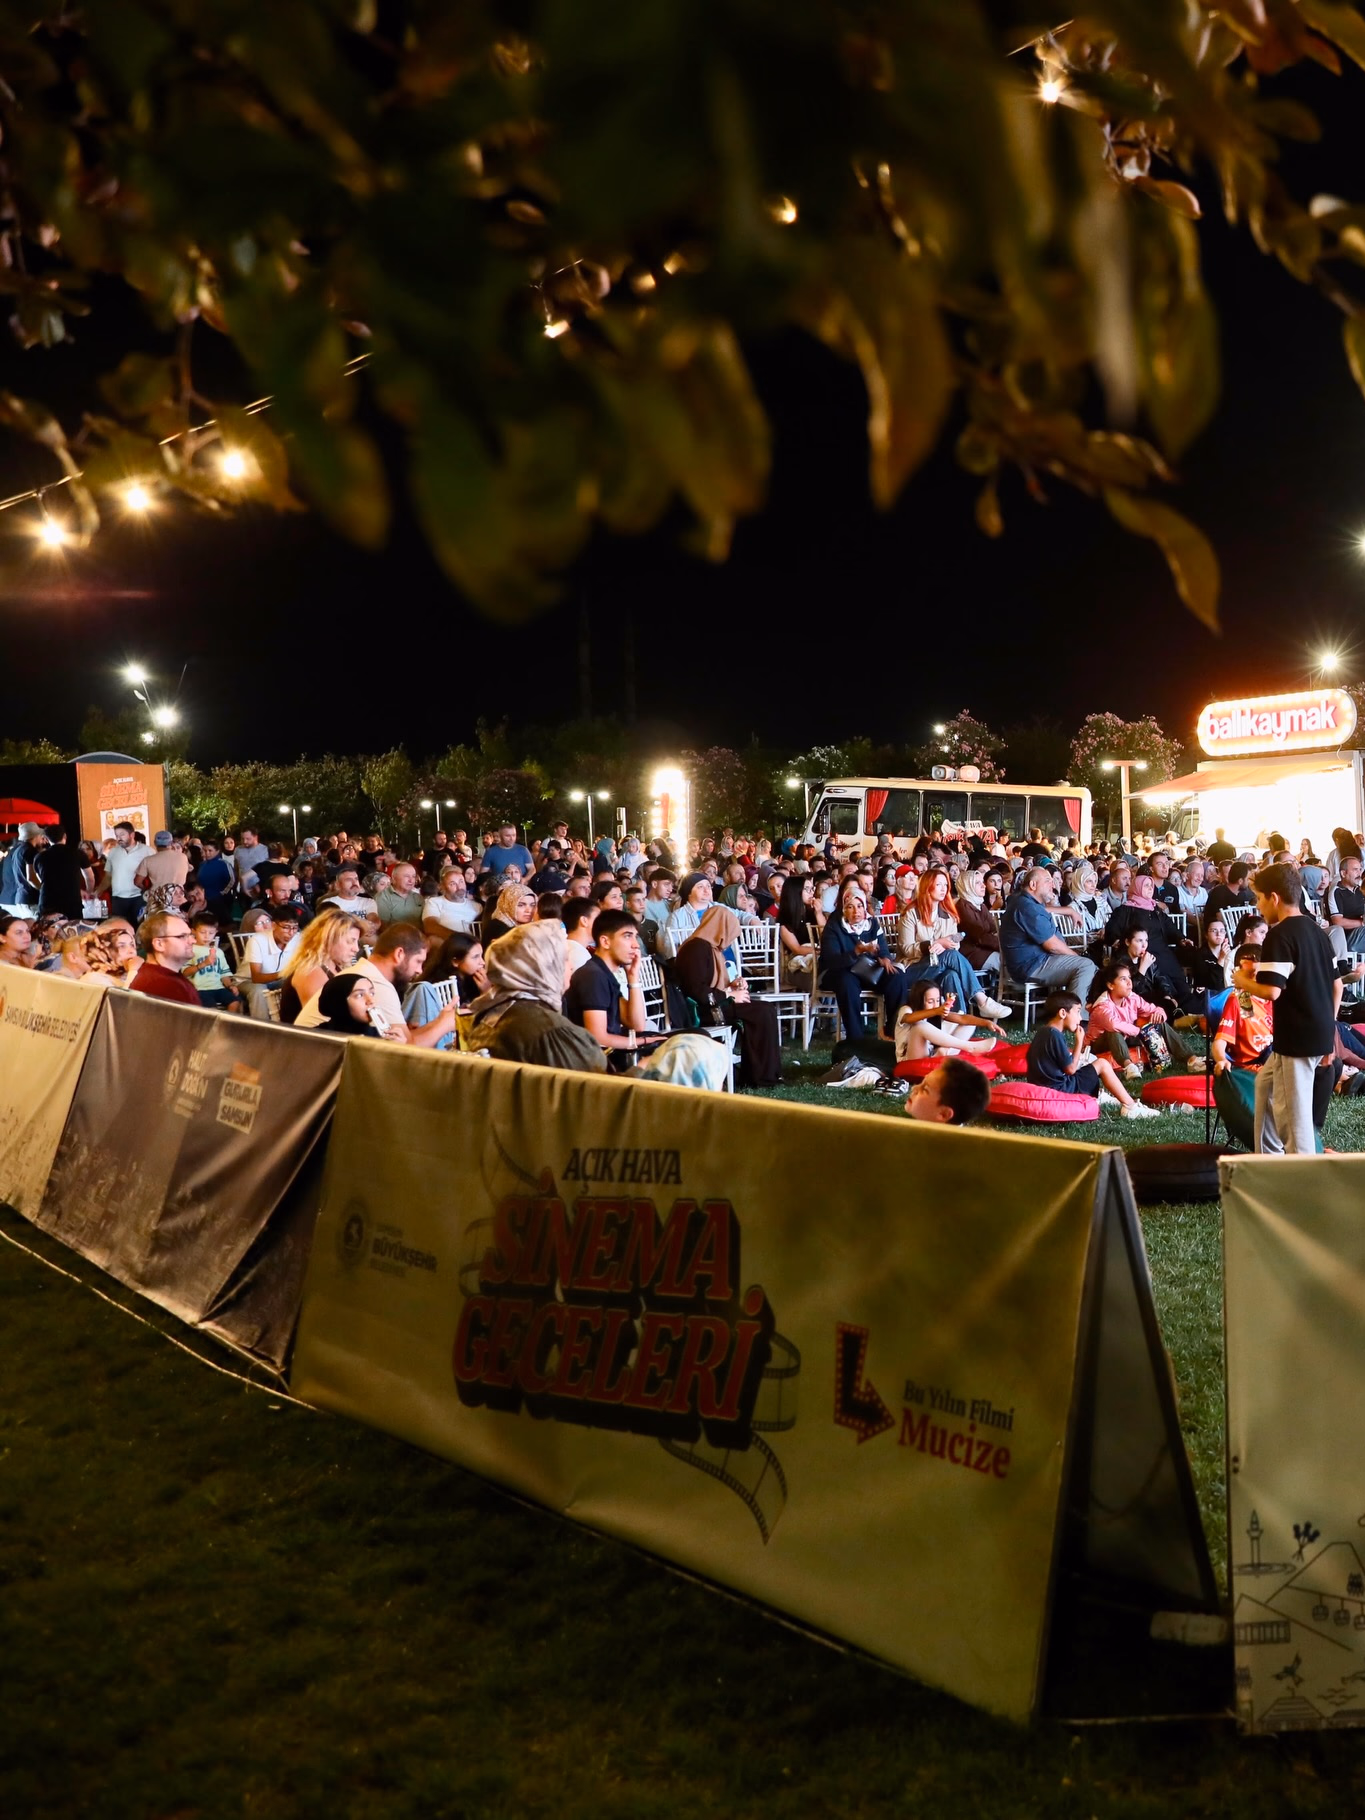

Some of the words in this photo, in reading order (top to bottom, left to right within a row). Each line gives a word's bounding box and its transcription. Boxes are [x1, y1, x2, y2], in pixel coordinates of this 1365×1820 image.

[219, 1104, 253, 1128] SAMSUN
[223, 1081, 259, 1106] GURURLA
[561, 1147, 619, 1194] AÇIK
[617, 1148, 683, 1185] HAVA
[481, 1166, 734, 1303] SİNEMA
[452, 1285, 768, 1424] GECELERİ
[904, 1378, 926, 1405] Bu
[969, 1398, 1015, 1433] Filmi
[897, 1406, 1011, 1479] Mucize
